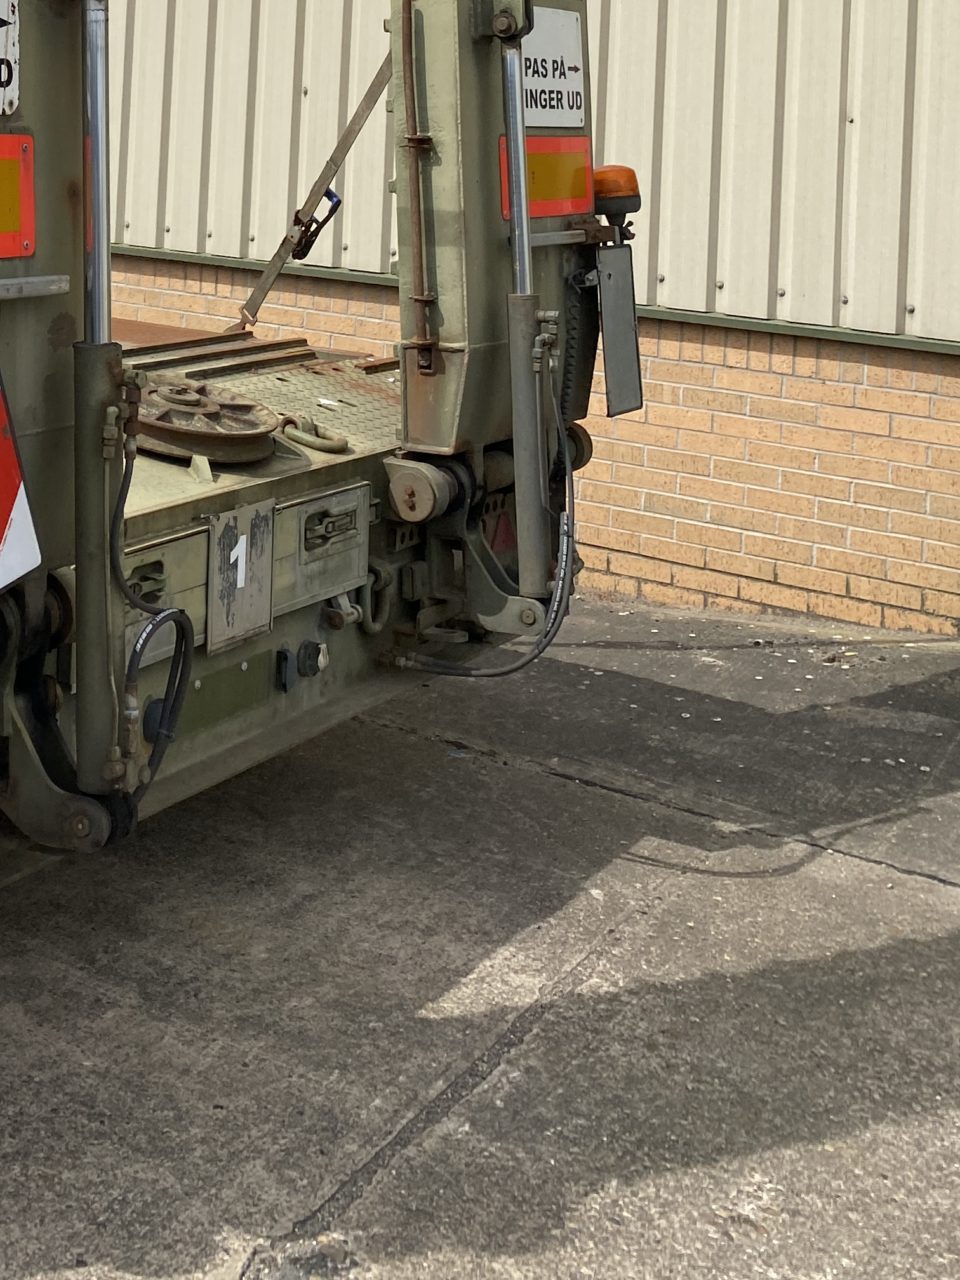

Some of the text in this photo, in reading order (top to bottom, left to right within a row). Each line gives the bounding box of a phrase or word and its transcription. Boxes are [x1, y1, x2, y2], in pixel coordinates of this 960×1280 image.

[524, 55, 567, 80] PAS PÅ
[525, 88, 583, 110] INGER UD
[229, 534, 247, 589] 1
